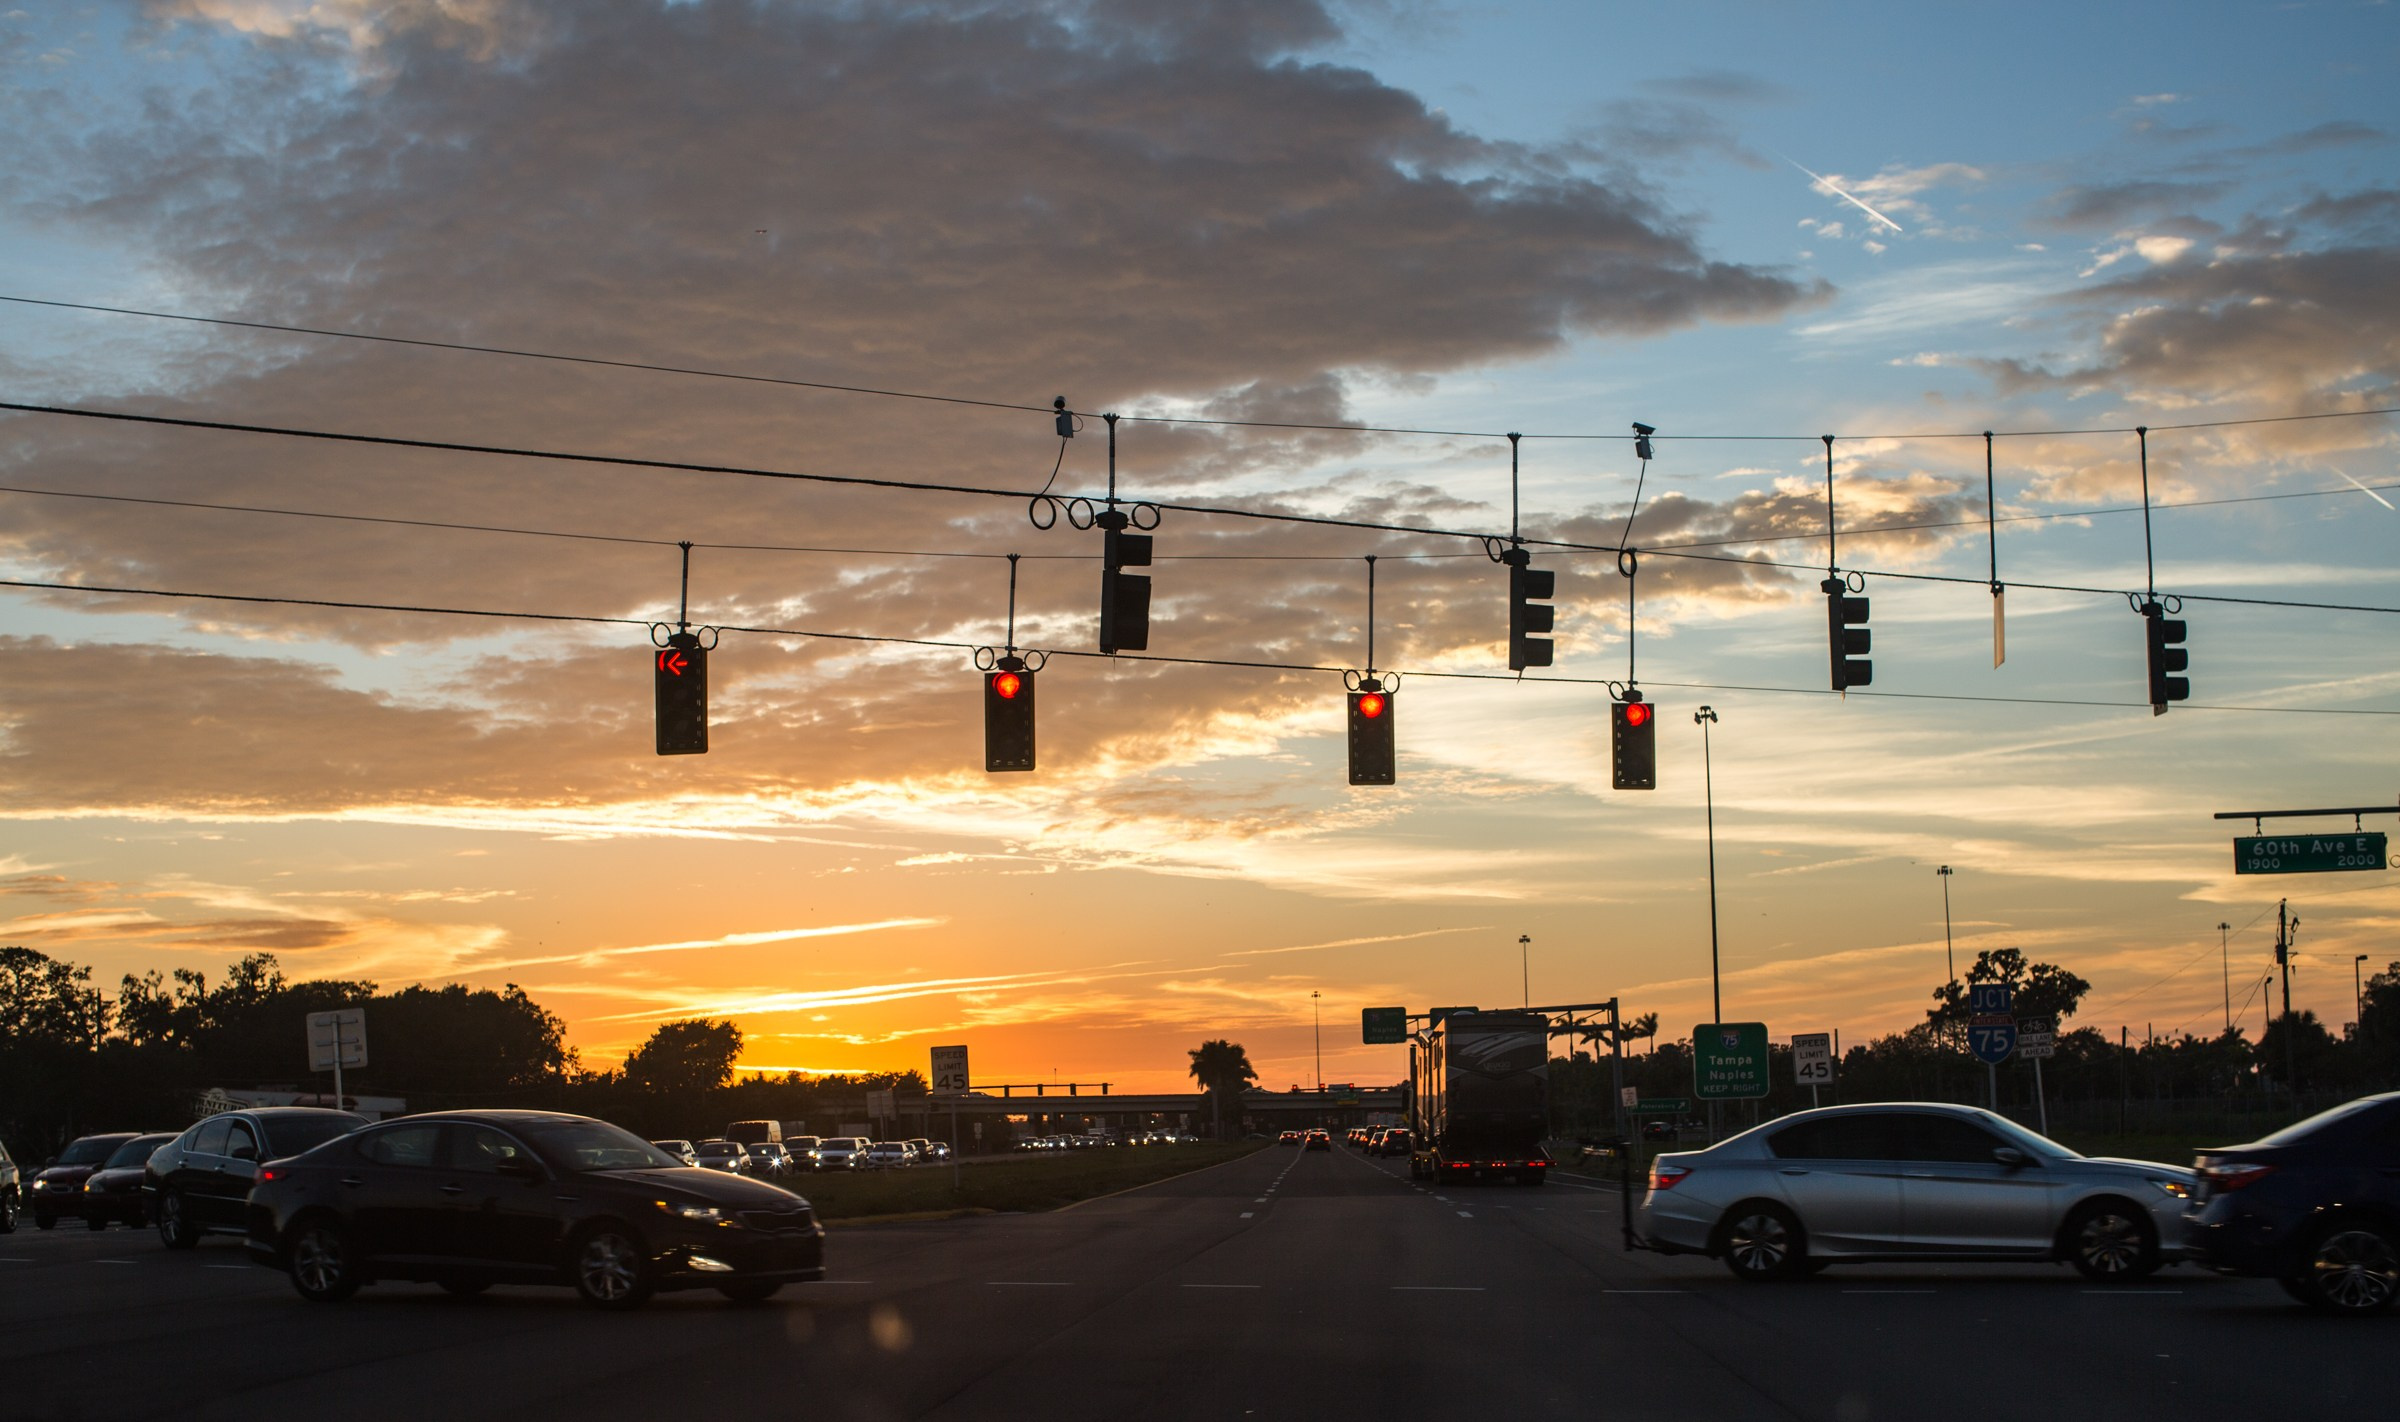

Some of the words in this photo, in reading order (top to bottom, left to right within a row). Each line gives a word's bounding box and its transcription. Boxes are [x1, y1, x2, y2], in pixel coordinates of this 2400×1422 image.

[2253, 840, 2300, 856] 60th
[2311, 839, 2346, 854] Ave
[2355, 837, 2367, 852] E
[2247, 857, 2280, 870] 1900
[2337, 854, 2376, 867] 2000
[1973, 988, 2008, 1009] JCT
[1723, 1034, 1738, 1046] 75
[1795, 1038, 1827, 1048] SPEED
[1975, 1029, 2009, 1053] 75
[2036, 1034, 2052, 1042] LANE
[935, 1051, 965, 1059] SPEED
[1799, 1050, 1824, 1060] LIMIT
[2025, 1047, 2051, 1057] AHEAD
[1708, 1055, 1753, 1067] Tampa
[938, 1063, 962, 1072] LIMIT
[1799, 1061, 1829, 1079] 45
[1709, 1070, 1755, 1082] Naples
[936, 1074, 965, 1091] 45
[1703, 1084, 1729, 1093] KEEP
[1733, 1083, 1761, 1093] RIGHT
